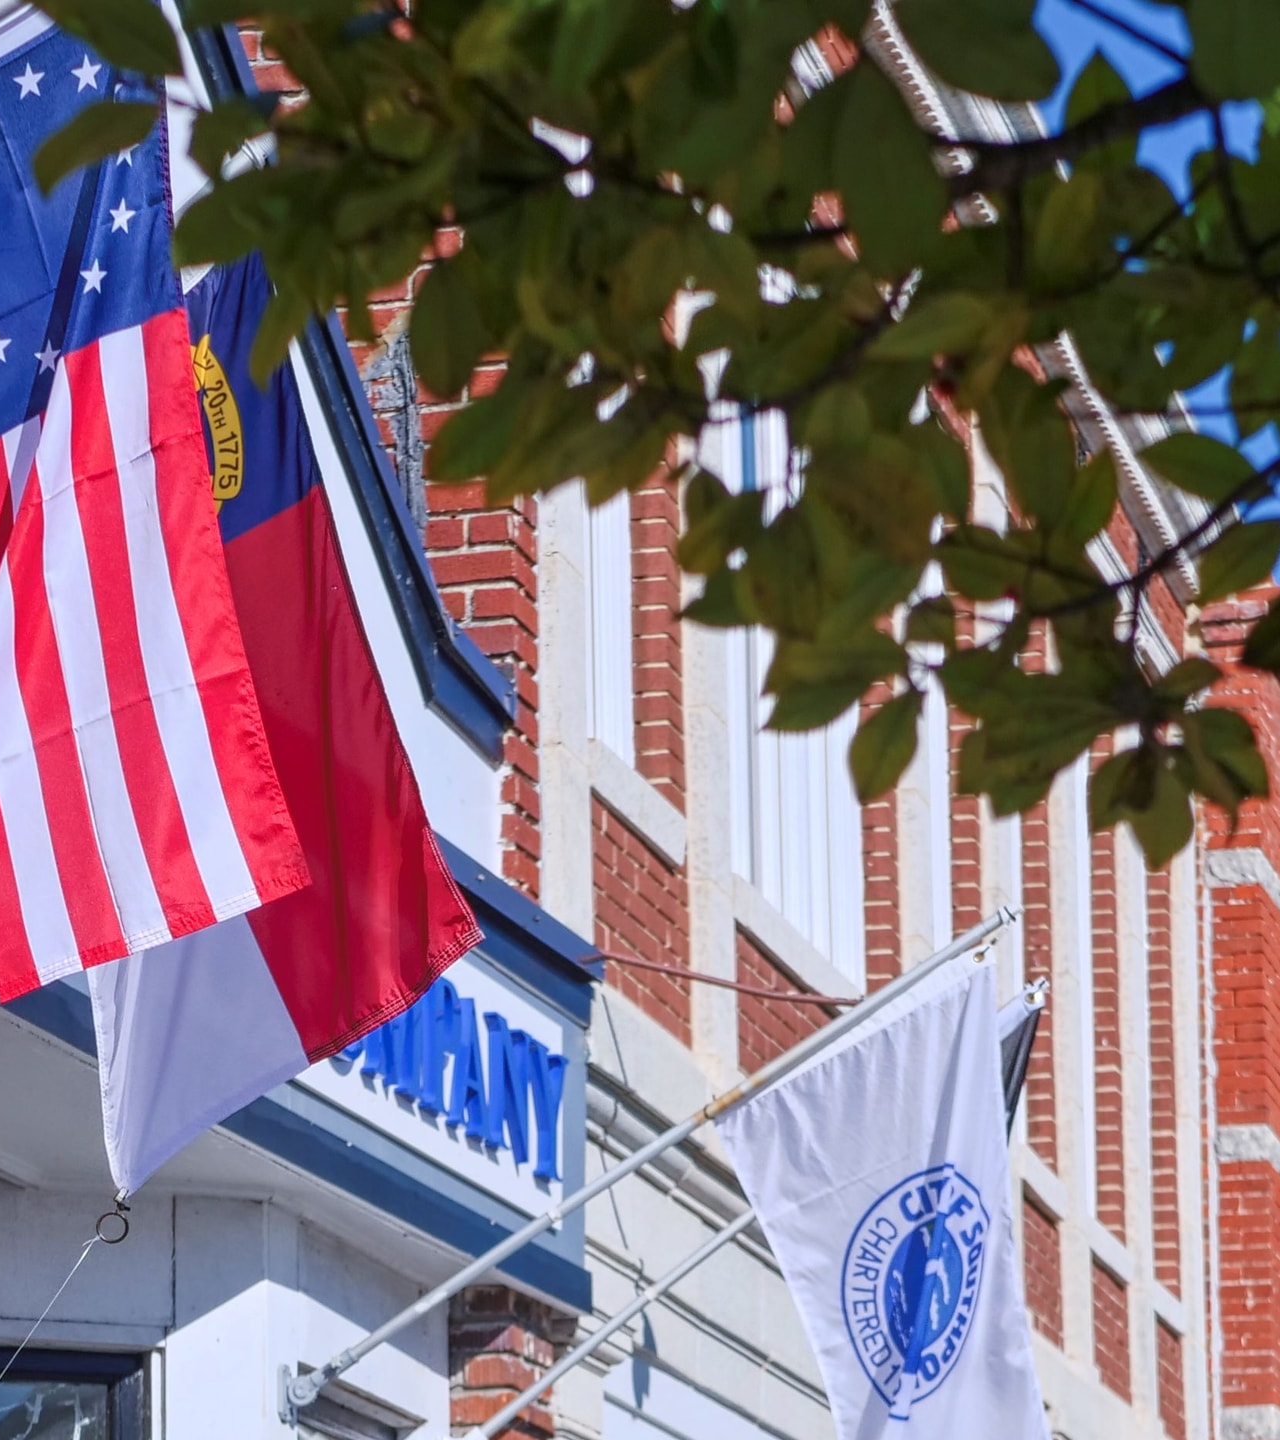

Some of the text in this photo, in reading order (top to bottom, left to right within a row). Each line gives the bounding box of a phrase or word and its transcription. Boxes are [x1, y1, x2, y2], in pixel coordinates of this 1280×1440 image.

[217, 431, 240, 490] 1775
[898, 1177, 954, 1222] CIT
[851, 1216, 898, 1369] CHARTERED
[915, 1220, 984, 1390] SOUTHPO
